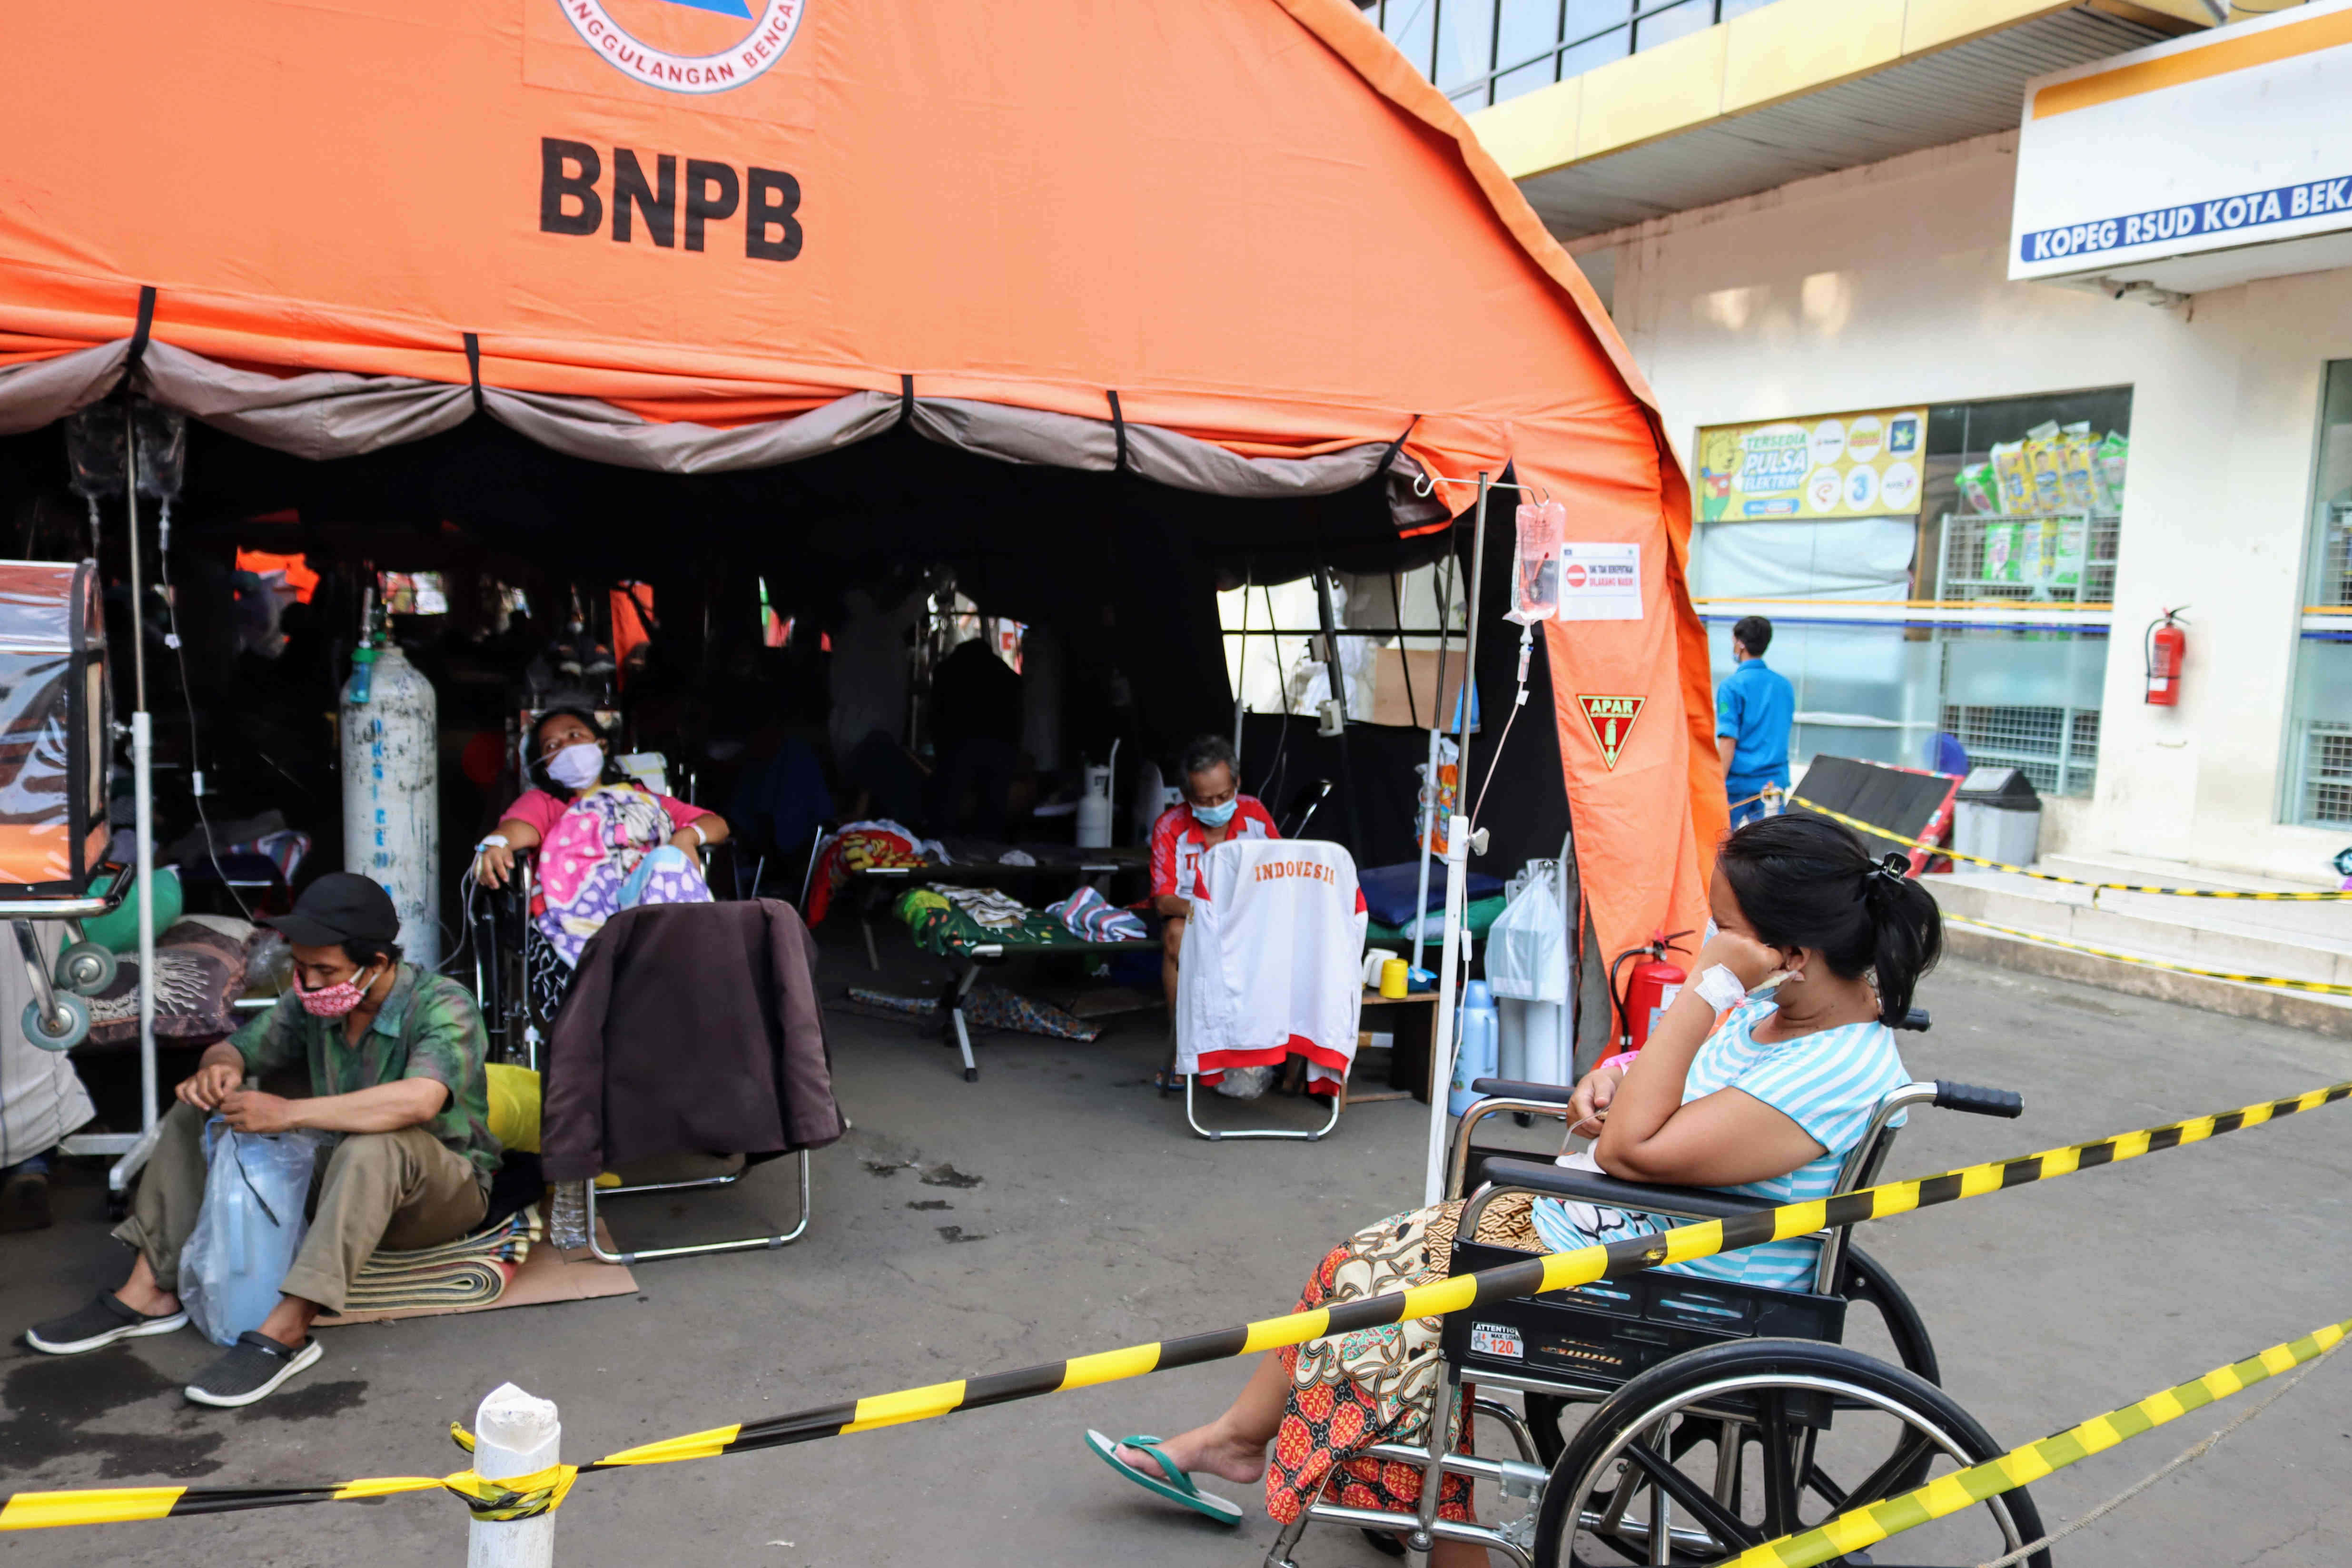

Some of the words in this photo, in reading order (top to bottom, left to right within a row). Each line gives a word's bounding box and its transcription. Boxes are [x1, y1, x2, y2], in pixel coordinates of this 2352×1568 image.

[568, 0, 735, 84] NGGULANGAN
[742, 0, 796, 68] BENCA
[540, 137, 803, 262] BNPB
[2034, 220, 2118, 260] KOPEG
[2125, 207, 2195, 245] RSUD
[2202, 191, 2282, 231] KOTA
[1747, 432, 1807, 449] TERSEDIA
[1744, 448, 1807, 475] PULSA
[1743, 474, 1799, 492] ELEKTRIK
[1590, 699, 1634, 713] APAR
[1476, 1324, 1517, 1334] ATTENTIO
[1491, 1339, 1514, 1354] 120
